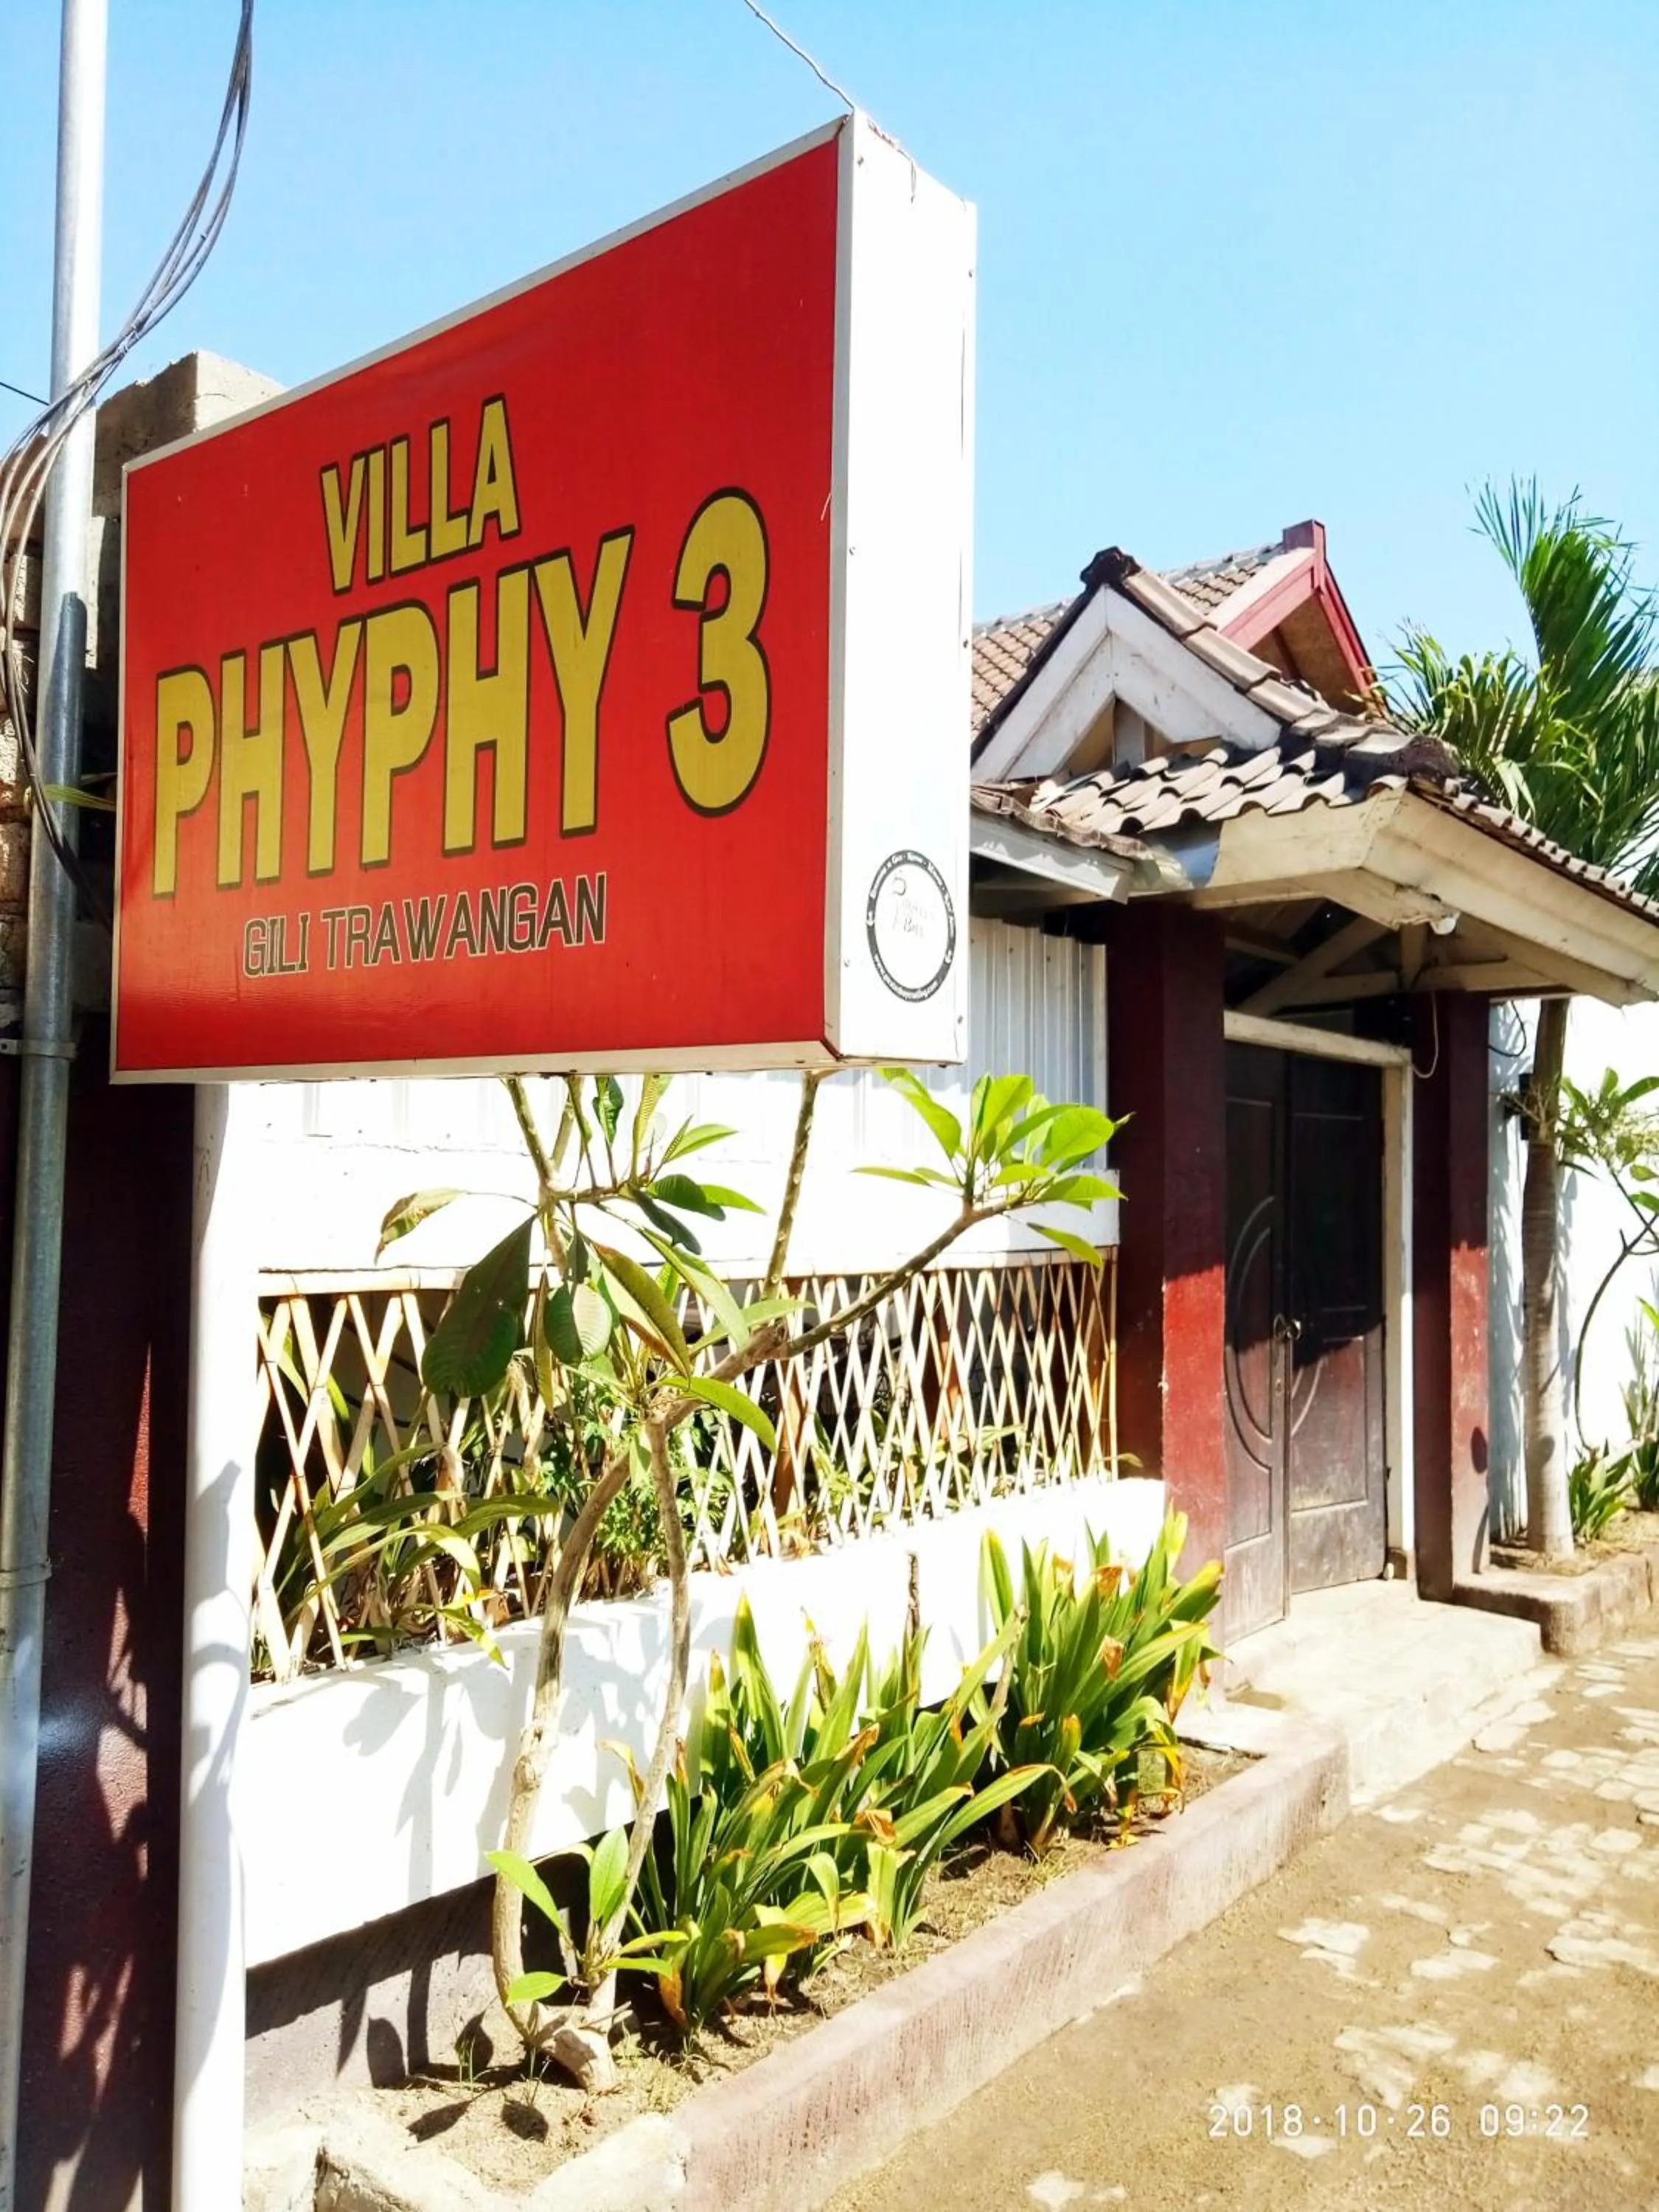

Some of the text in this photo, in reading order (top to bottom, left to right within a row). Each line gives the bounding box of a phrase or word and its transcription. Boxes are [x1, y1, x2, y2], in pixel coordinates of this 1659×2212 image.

[321, 394, 521, 595] VILLA
[153, 487, 771, 900] PHYPHY 3
[244, 872, 608, 978] GILI TRAWANGAN
